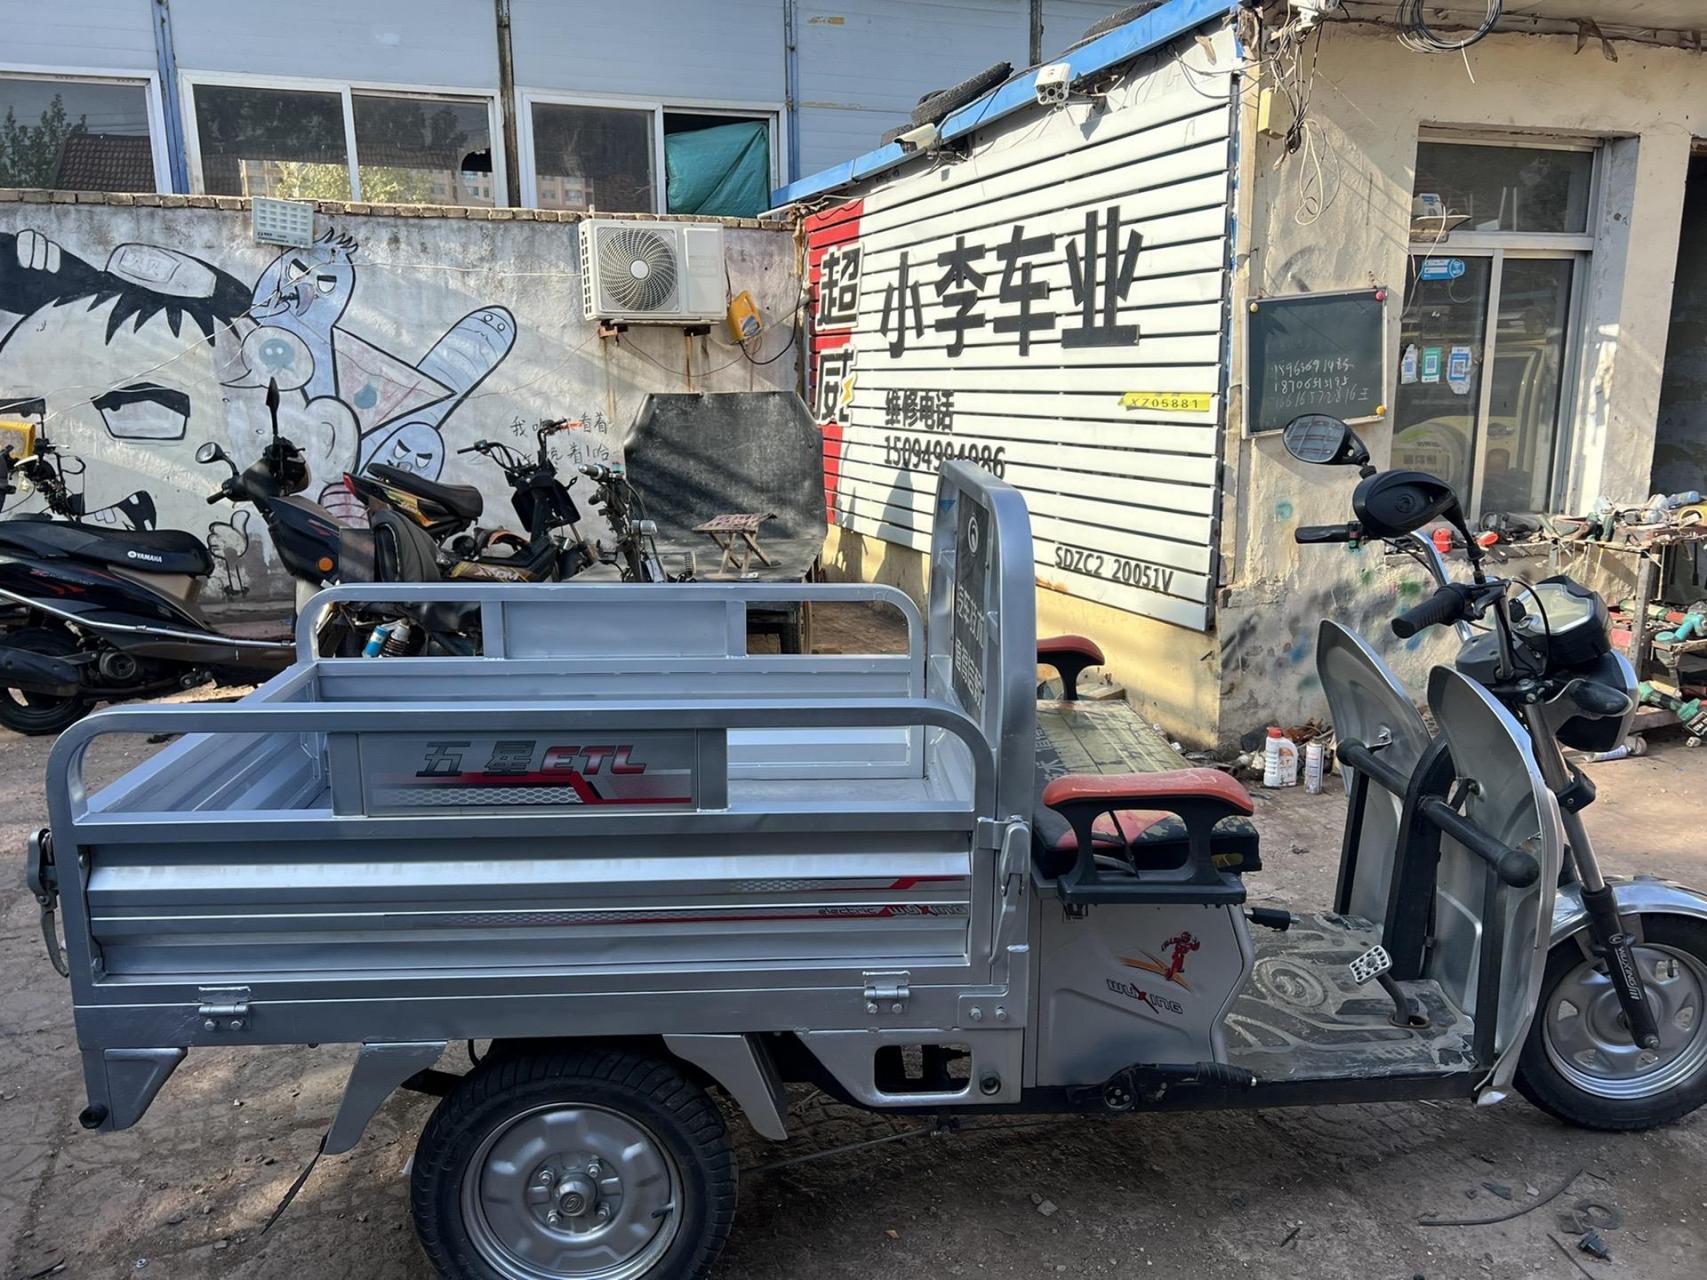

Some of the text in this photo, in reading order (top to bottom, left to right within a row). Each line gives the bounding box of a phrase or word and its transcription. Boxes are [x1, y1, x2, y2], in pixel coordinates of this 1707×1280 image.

[879, 206, 1144, 359] 小李车业
[885, 390, 955, 432] 维修电话
[136, 552, 162, 563] YAMAHA
[1055, 546, 1175, 592] SDZC2 20051V
[415, 741, 536, 777] 五星
